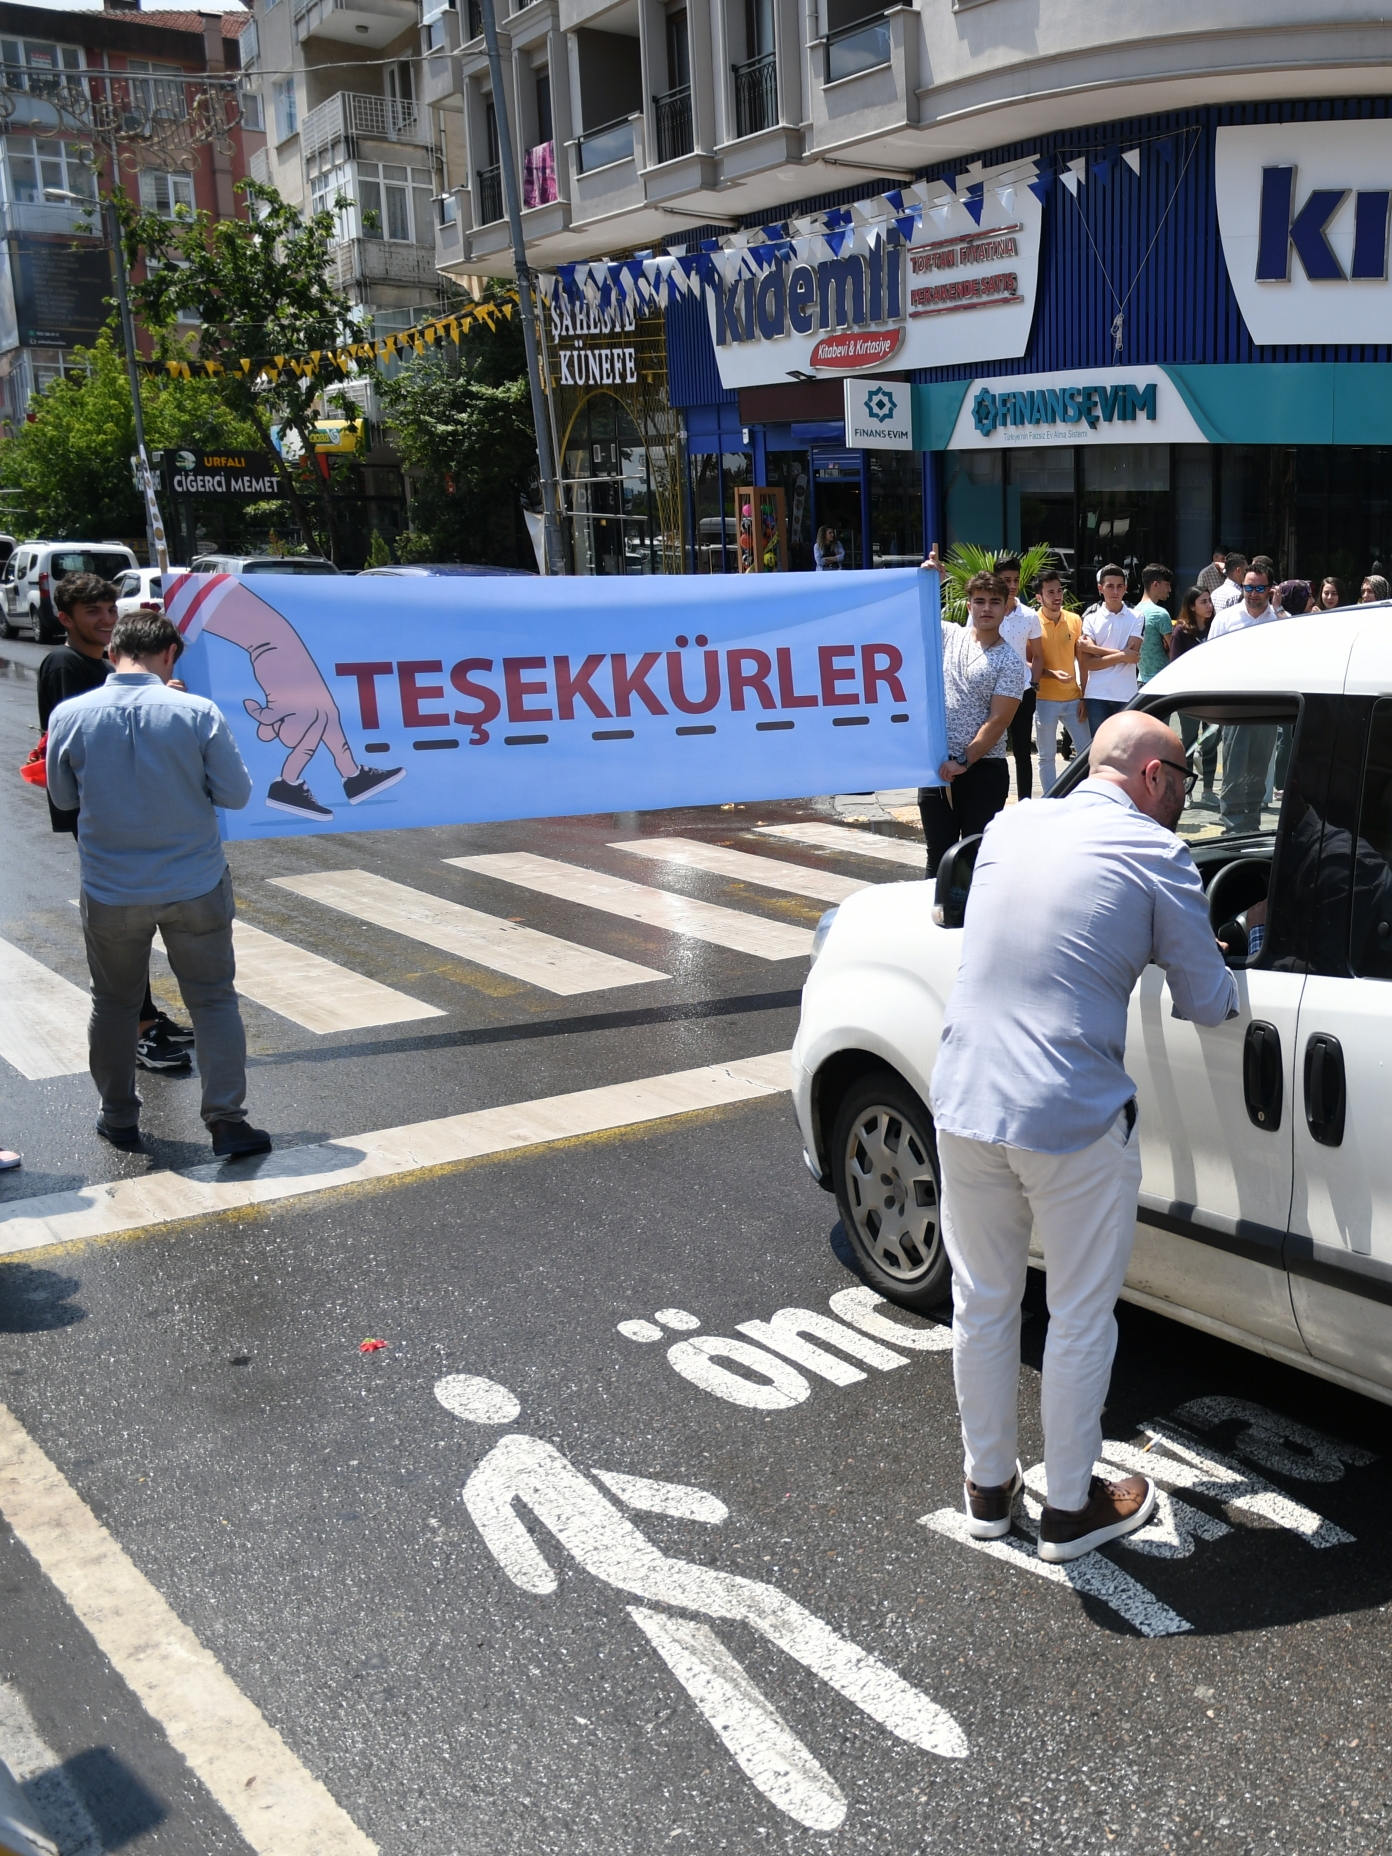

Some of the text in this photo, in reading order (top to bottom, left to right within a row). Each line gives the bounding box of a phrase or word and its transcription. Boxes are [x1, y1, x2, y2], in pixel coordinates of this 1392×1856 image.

[910, 249, 957, 275] TOPTAN
[911, 278, 980, 307] PERAKENDE
[817, 336, 891, 360] Kitabevi & Kırtasiye
[559, 340, 637, 385] KÜNEFE
[1053, 430, 1067, 439] Alma
[1067, 429, 1088, 439] Sistemi
[203, 456, 246, 468] URFALI
[173, 472, 227, 493] CİĞERCİ
[230, 476, 279, 493] MEMET
[335, 634, 908, 746] TEŞEKKÜRLER
[617, 1285, 954, 1410] önc
